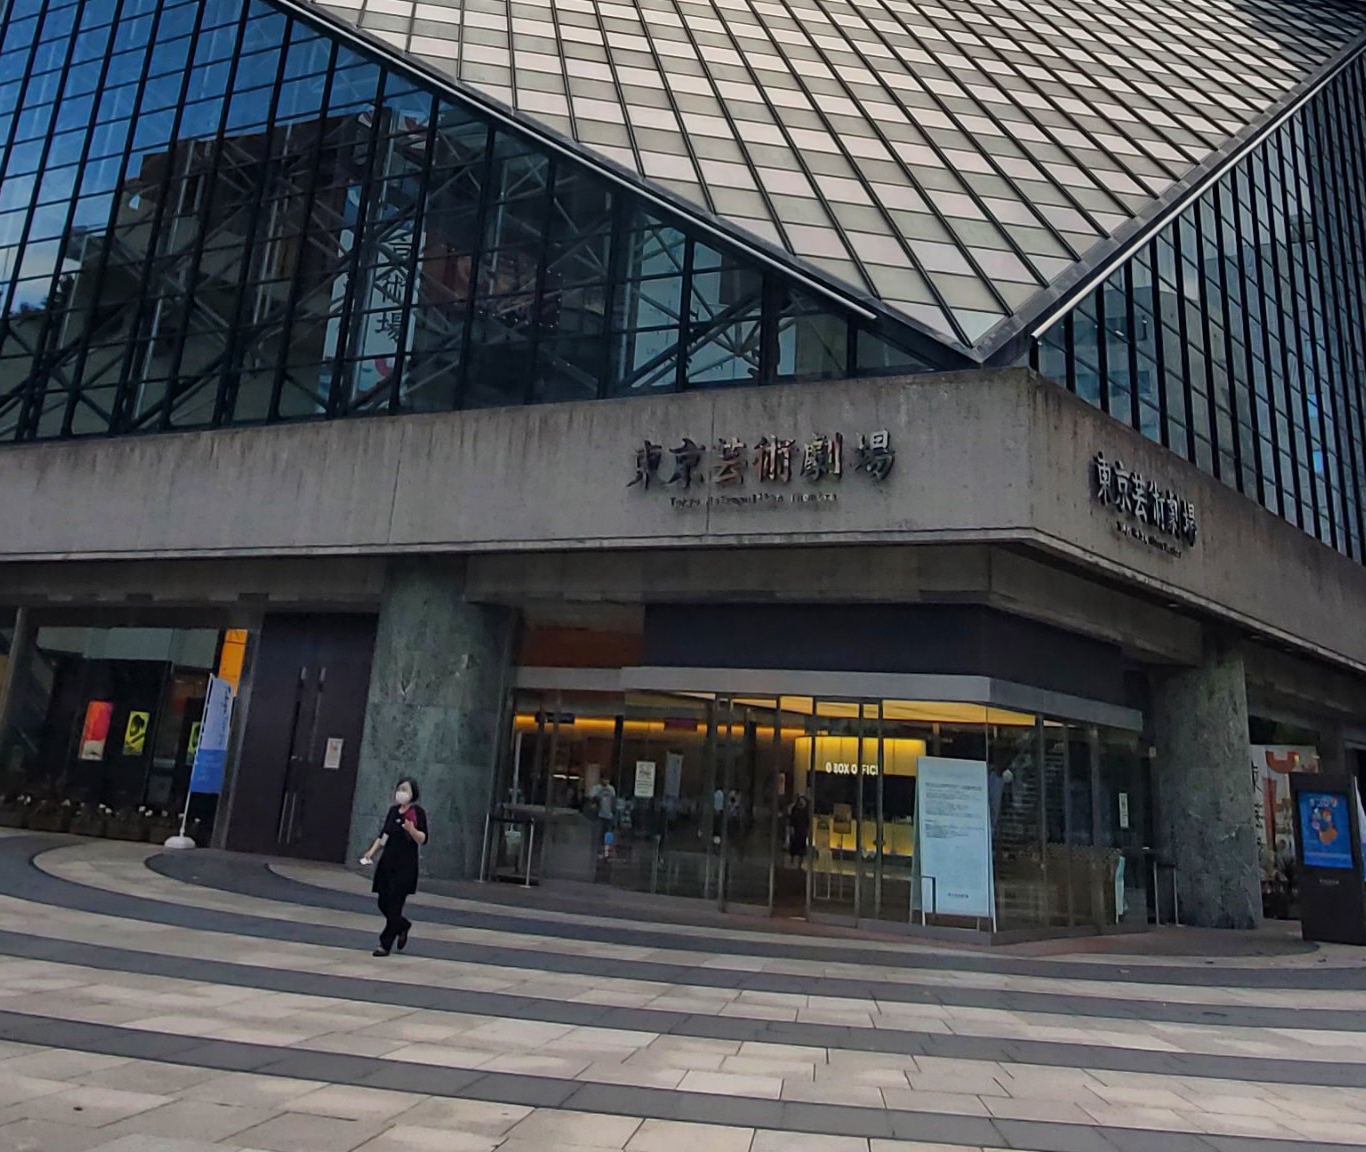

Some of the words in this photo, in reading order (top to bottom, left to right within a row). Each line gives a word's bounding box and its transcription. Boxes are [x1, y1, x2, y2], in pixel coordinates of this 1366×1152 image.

[626, 428, 896, 490] 東京芸術劇場
[1092, 451, 1197, 547] 東京芸術劇場
